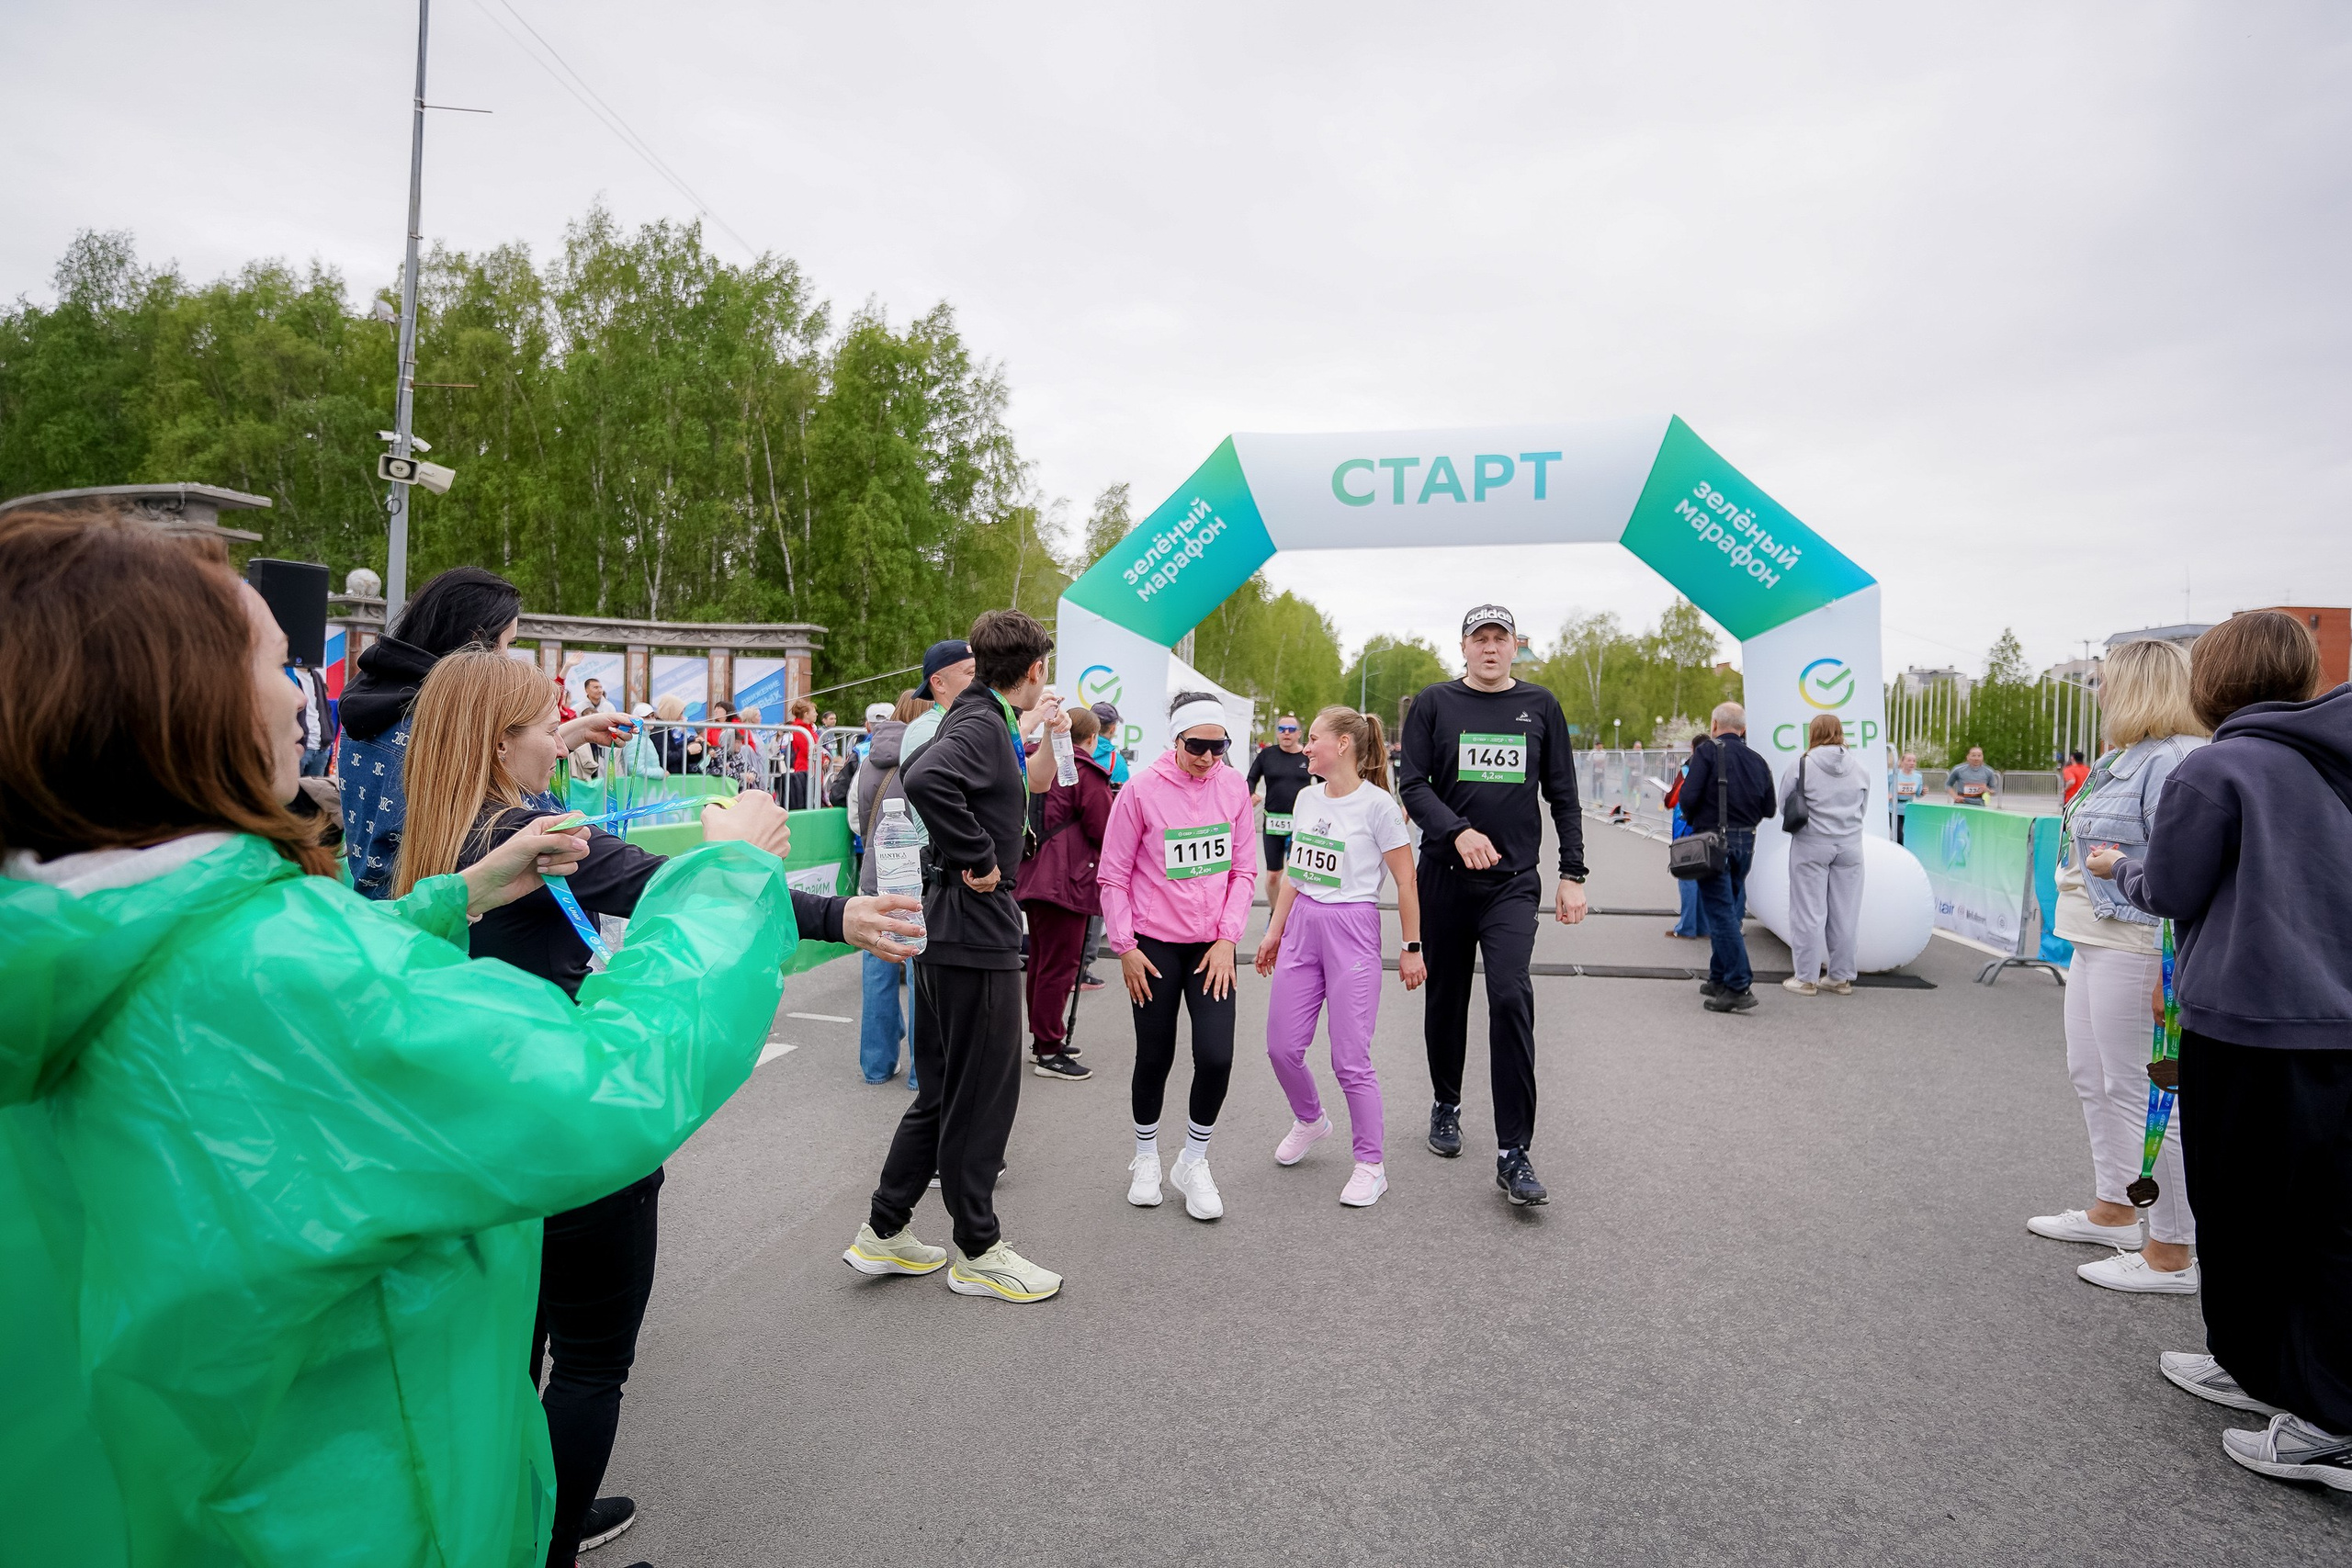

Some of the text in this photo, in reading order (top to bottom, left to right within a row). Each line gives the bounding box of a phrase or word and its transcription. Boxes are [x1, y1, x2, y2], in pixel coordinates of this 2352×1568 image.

[1331, 451, 1562, 506] СТАРТ
[1692, 479, 1803, 570] зелёный
[1123, 497, 1213, 586] зелёный
[1674, 498, 1781, 589] марафон
[1136, 516, 1227, 603] марафон
[1467, 608, 1512, 625] adidas
[1772, 721, 1878, 751] СЕР
[1467, 748, 1520, 767] 1463
[1270, 819, 1291, 829] 1451
[1173, 838, 1226, 863] 1115
[1296, 846, 1337, 872] 1150
